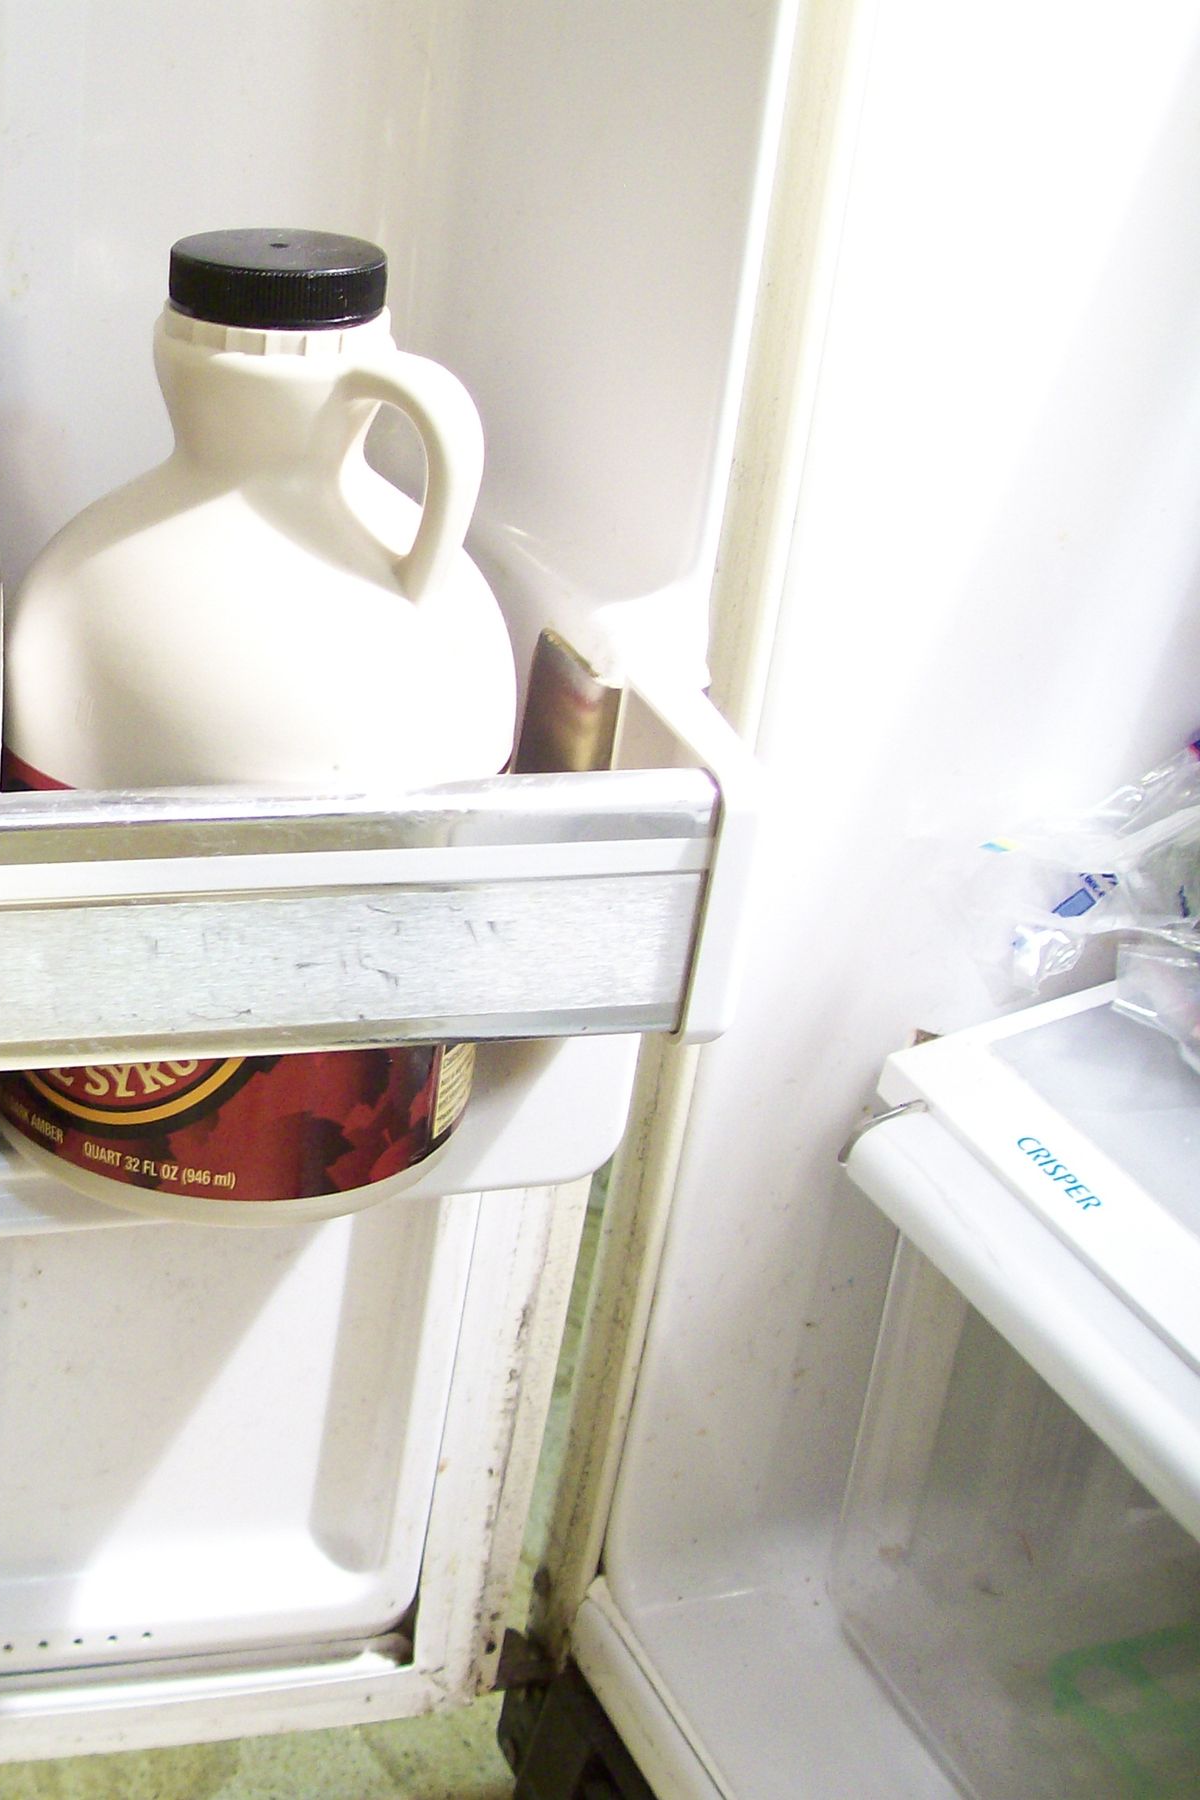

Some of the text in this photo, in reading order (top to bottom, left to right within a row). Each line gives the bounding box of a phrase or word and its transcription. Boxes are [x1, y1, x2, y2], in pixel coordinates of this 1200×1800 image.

[30, 1112, 65, 1145] AMBER
[83, 1141, 237, 1189] QUART 32 FL OZ (946 ml)
[1017, 1137, 1101, 1210] CRISPER
